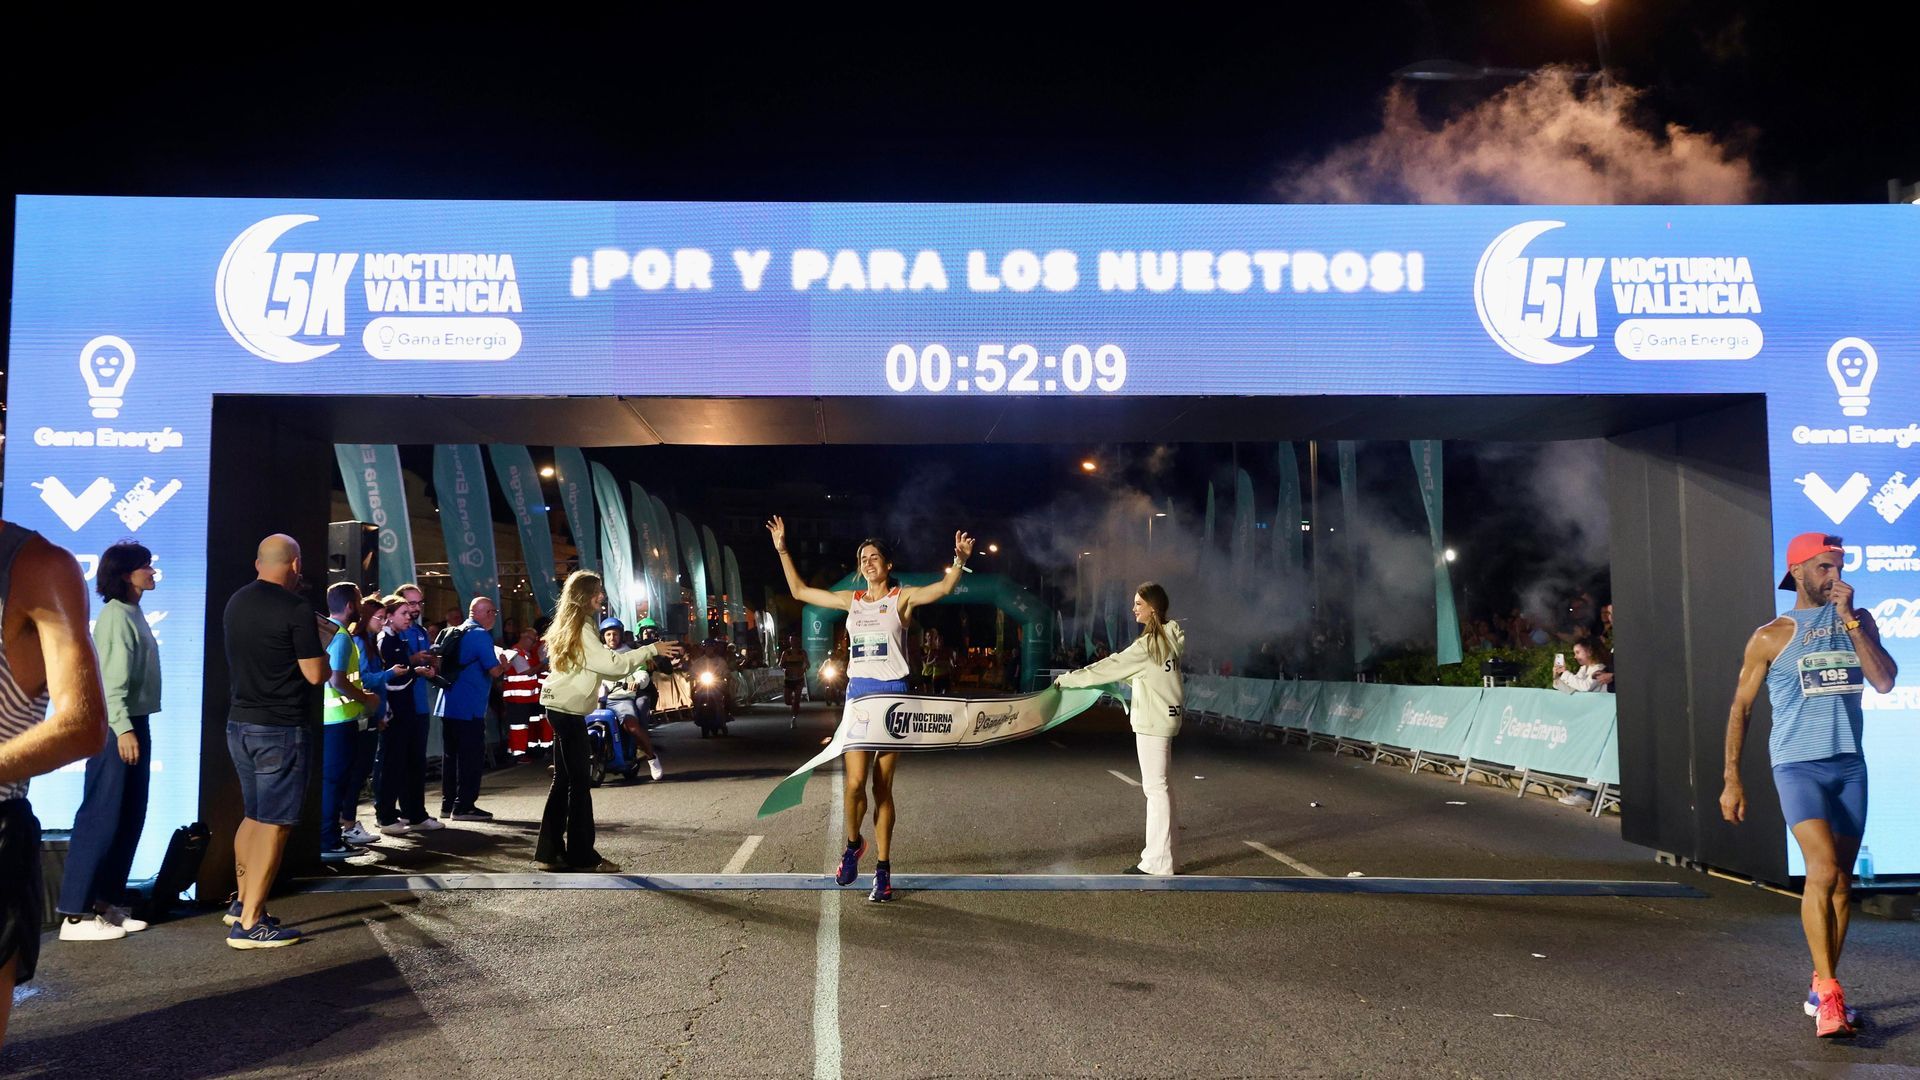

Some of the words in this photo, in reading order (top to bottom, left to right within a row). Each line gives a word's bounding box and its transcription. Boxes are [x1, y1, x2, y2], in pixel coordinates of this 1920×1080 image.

[364, 253, 516, 281] NOCTURNA
[571, 249, 713, 297] ¡POR
[732, 249, 771, 291] Y
[791, 249, 948, 291] PARA
[966, 249, 1079, 292] LOS
[1098, 250, 1424, 293] NUESTROS!
[1611, 257, 1754, 283] NOCTURNA
[364, 281, 523, 312] VALENCIA
[1612, 284, 1762, 313] VALENCIA
[398, 333, 440, 346] Gana
[1647, 334, 1687, 346] Gana
[885, 343, 1127, 393] 00:52:09
[34, 427, 95, 446] Gana
[97, 427, 183, 453] Energía
[1792, 426, 1847, 444] Gana
[1819, 669, 1848, 682] 195
[890, 712, 913, 733] 15K
[912, 713, 953, 723] NOCTURNA
[912, 722, 952, 733] VALENCIA
